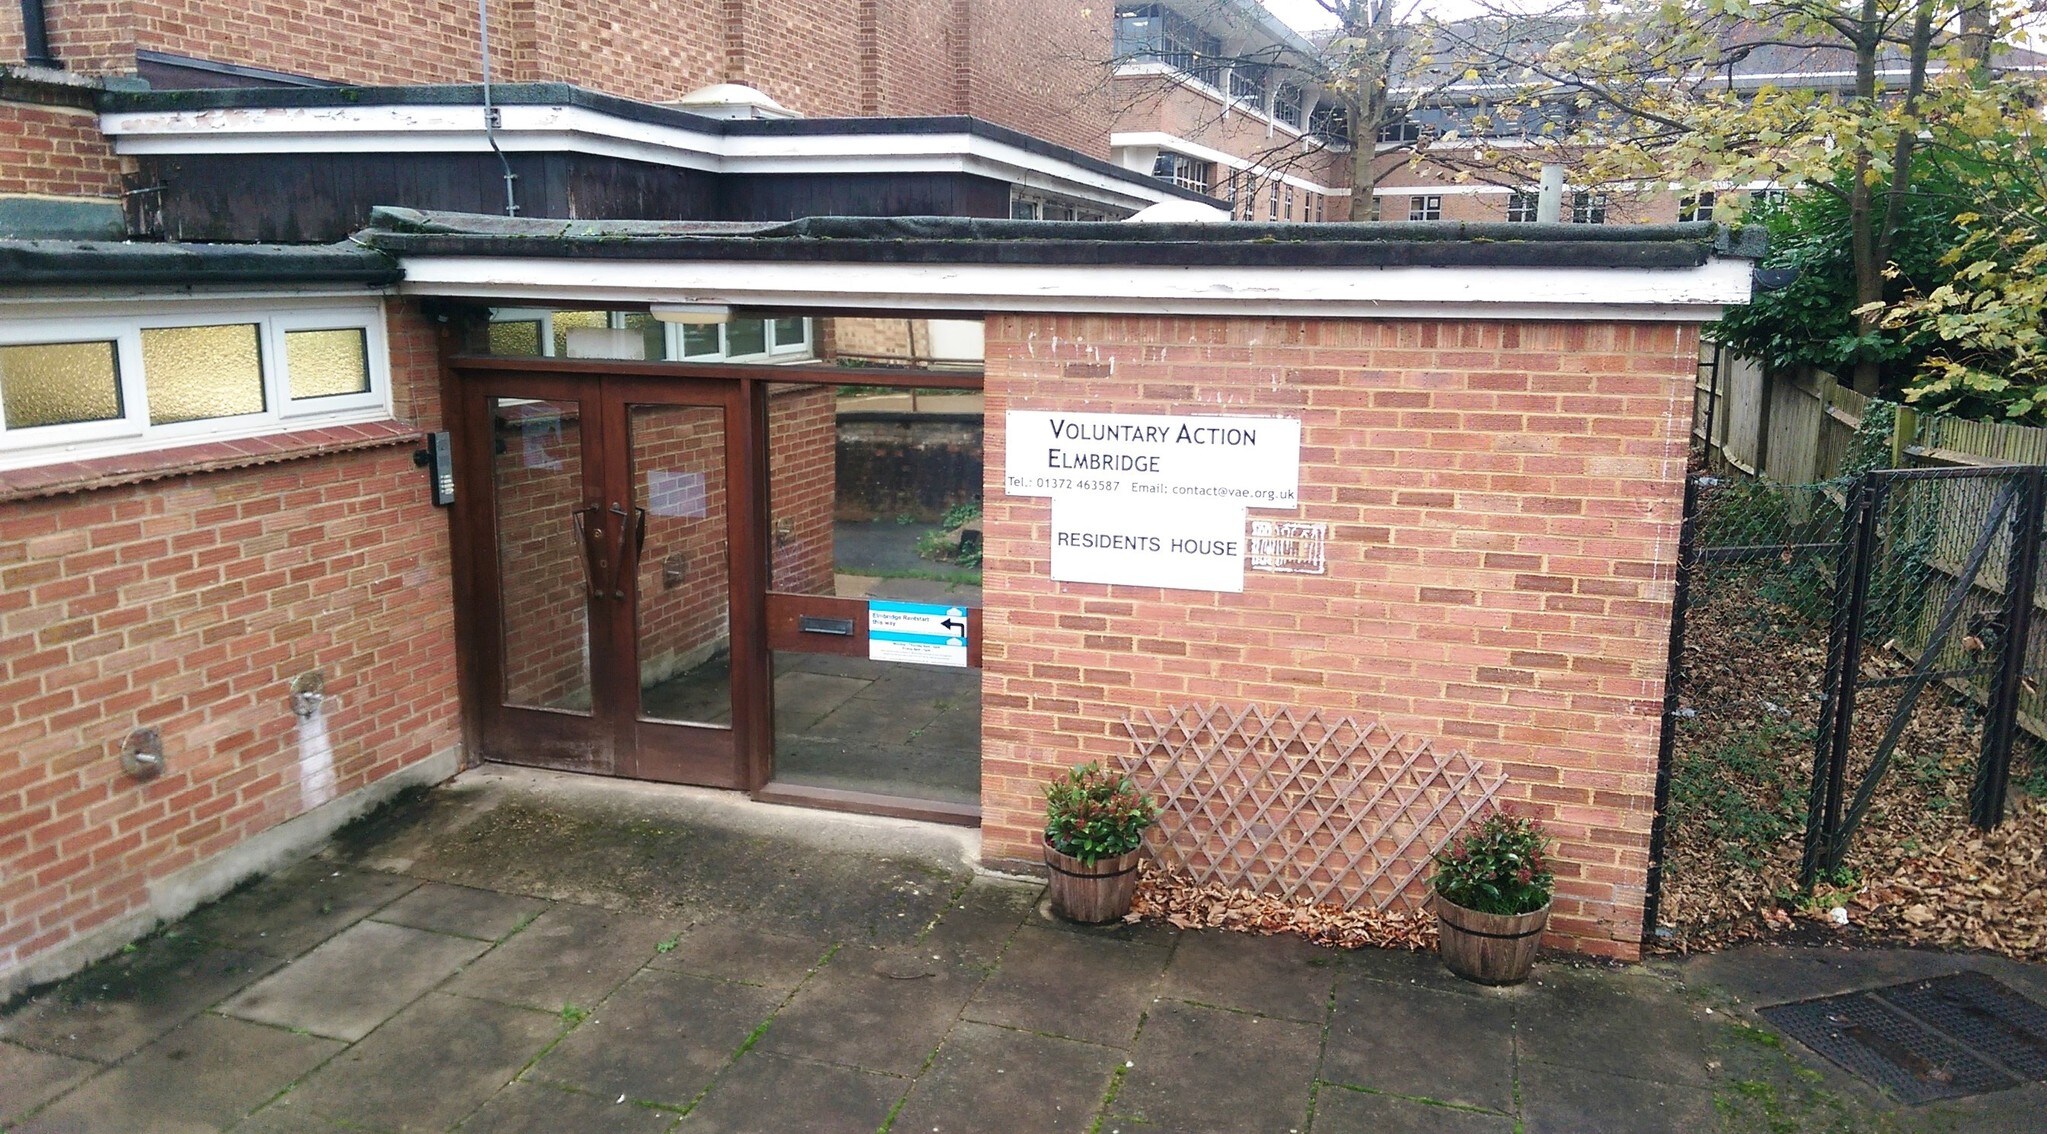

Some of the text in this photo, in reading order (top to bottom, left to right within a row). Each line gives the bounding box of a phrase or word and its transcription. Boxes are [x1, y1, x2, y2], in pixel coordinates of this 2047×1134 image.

[1049, 418, 1257, 446] VOLUNTARY ACTION
[1048, 448, 1161, 473] ELMBRIDGE
[1007, 476, 1296, 502] Tel.: 01372 463587 Email: contact@vae.org.uk
[1057, 531, 1238, 557] RESIDENTS HOUSE
